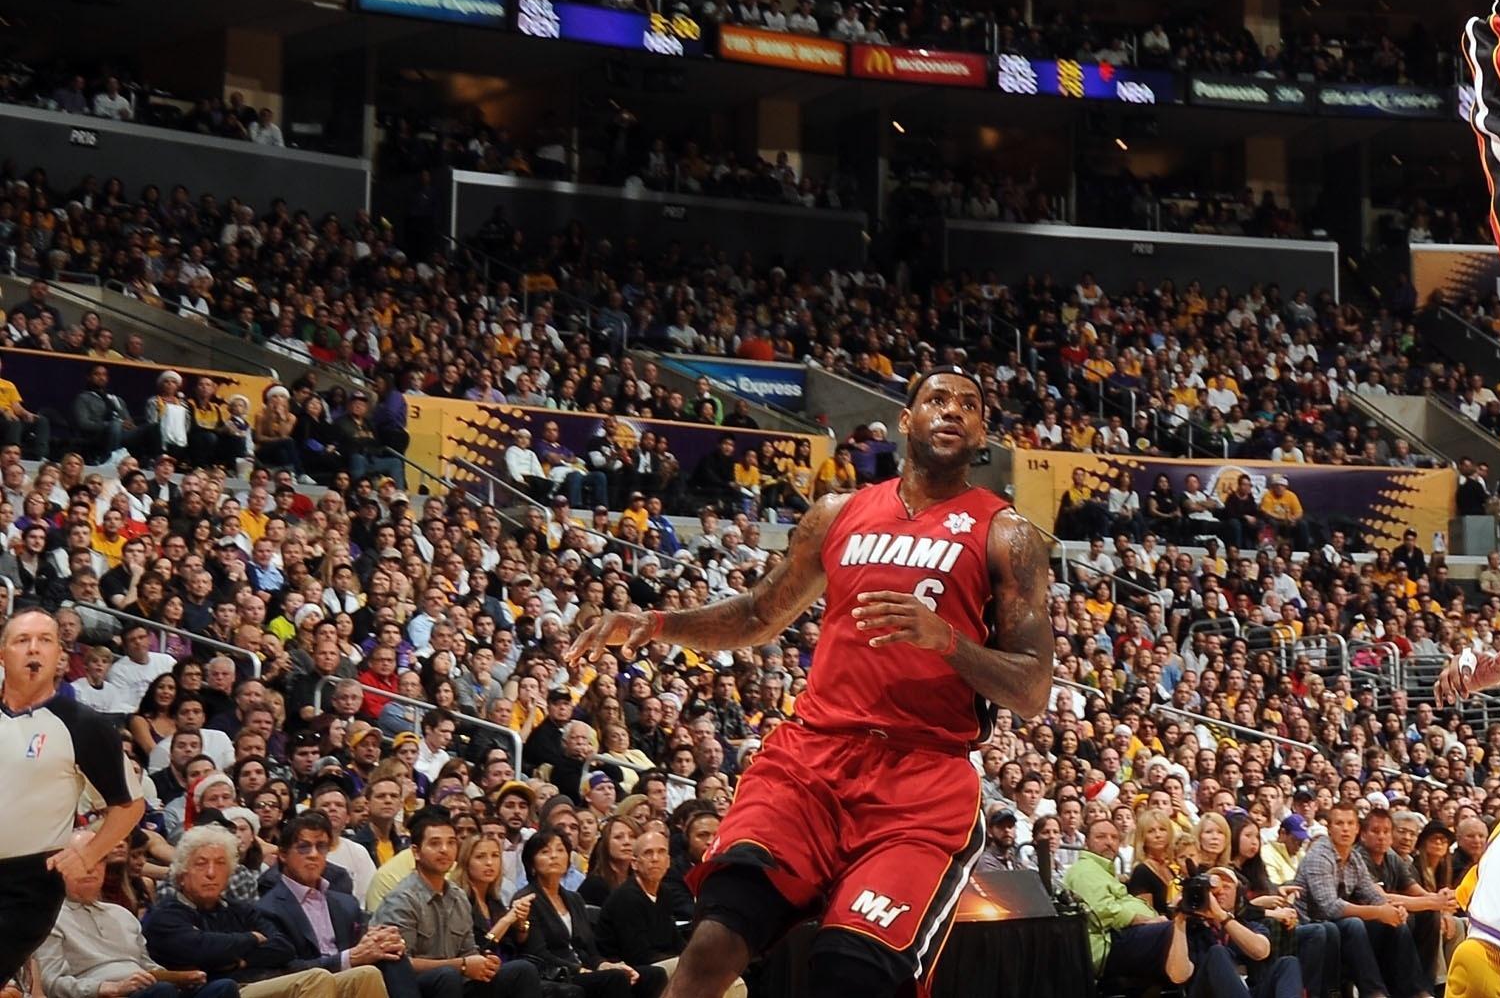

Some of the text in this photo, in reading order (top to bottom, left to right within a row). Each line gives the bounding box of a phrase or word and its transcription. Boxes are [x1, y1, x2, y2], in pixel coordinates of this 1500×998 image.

[736, 373, 802, 397] Express
[1026, 459, 1049, 471] 114
[840, 532, 964, 573] MIAMI
